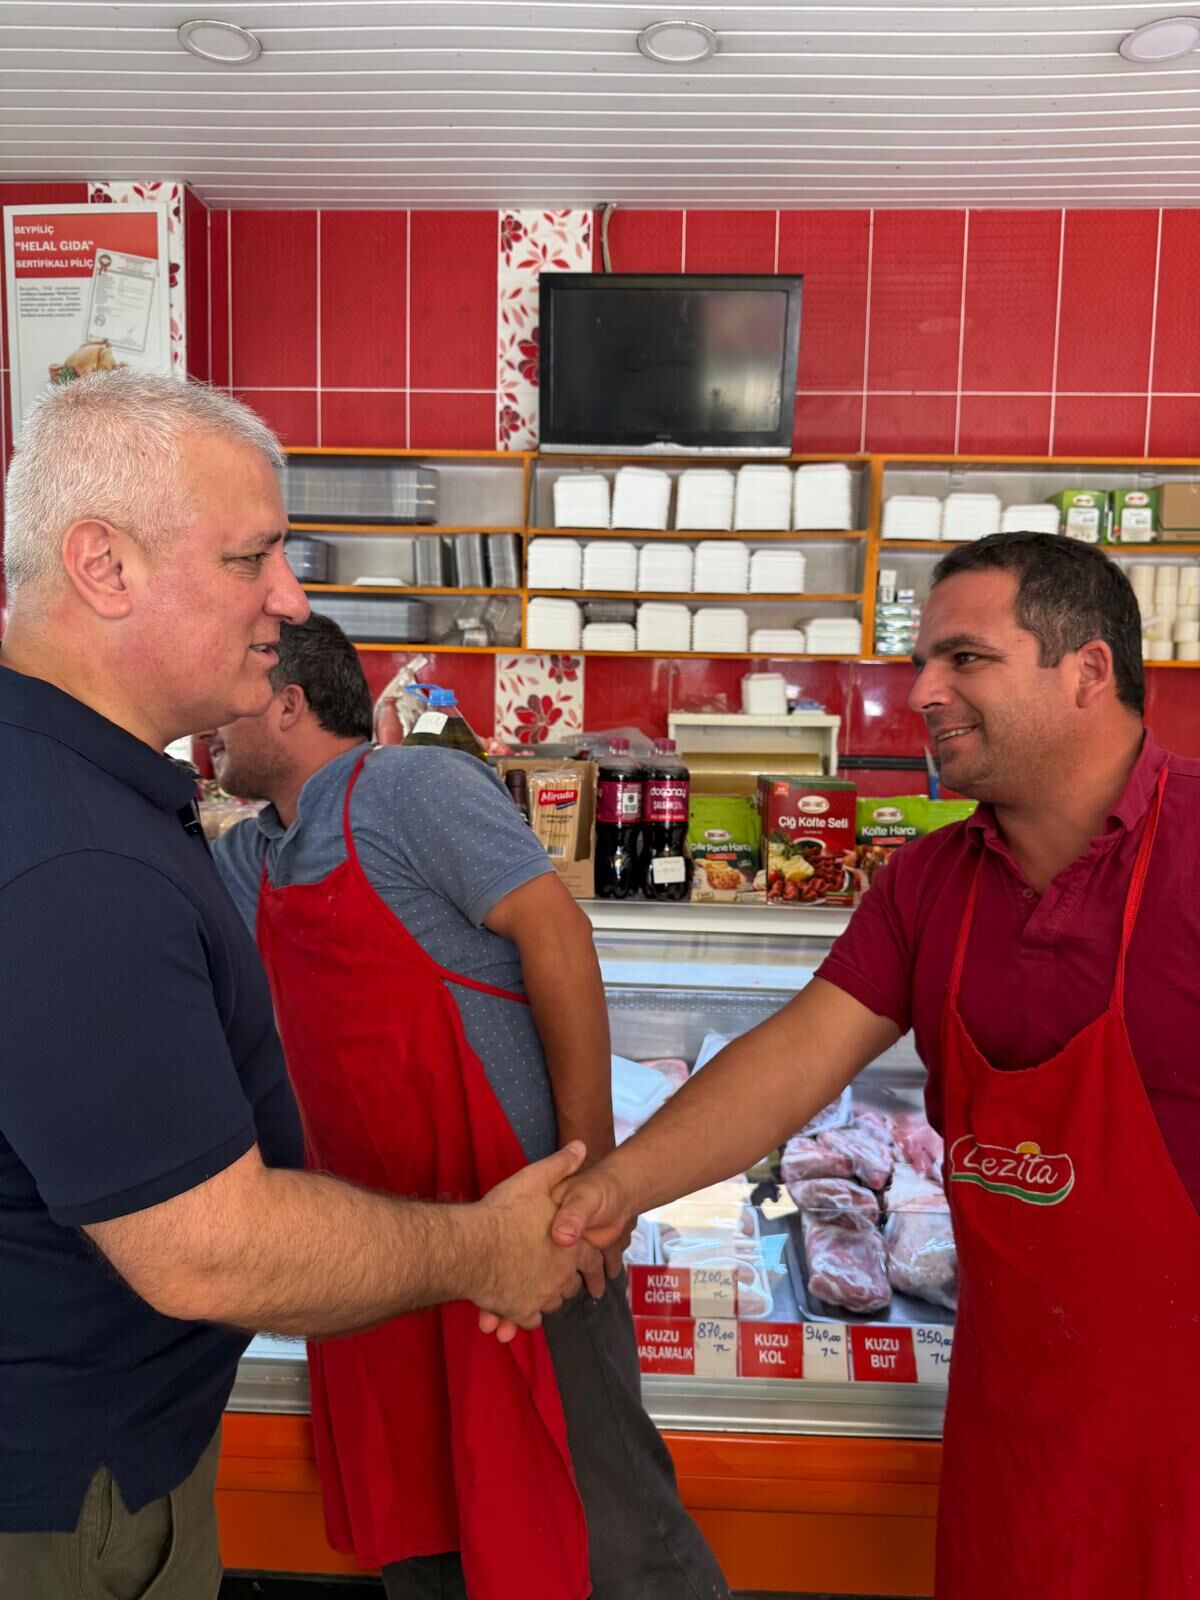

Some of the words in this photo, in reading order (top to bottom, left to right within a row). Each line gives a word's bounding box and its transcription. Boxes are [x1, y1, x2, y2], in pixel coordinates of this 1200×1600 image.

[14, 223, 54, 236] BEYPİLİÇ
[16, 258, 69, 268] SERTİFİKALI
[70, 257, 94, 270] PİLİÇ
[778, 816, 796, 829] Çiğ
[799, 816, 826, 828] Köfte
[827, 817, 848, 829] Seti
[862, 826, 886, 836] Köfte
[889, 825, 916, 836] Harcı
[962, 1146, 1059, 1184] Lezita
[647, 1275, 679, 1288] KUZU
[644, 1288, 681, 1303] CİĞER
[645, 1329, 680, 1342] KUZU
[754, 1333, 789, 1347] KUZU
[805, 1324, 841, 1342] 940,00
[864, 1337, 900, 1352] KUZU
[758, 1350, 786, 1364] KOL
[870, 1354, 897, 1368] BUT
